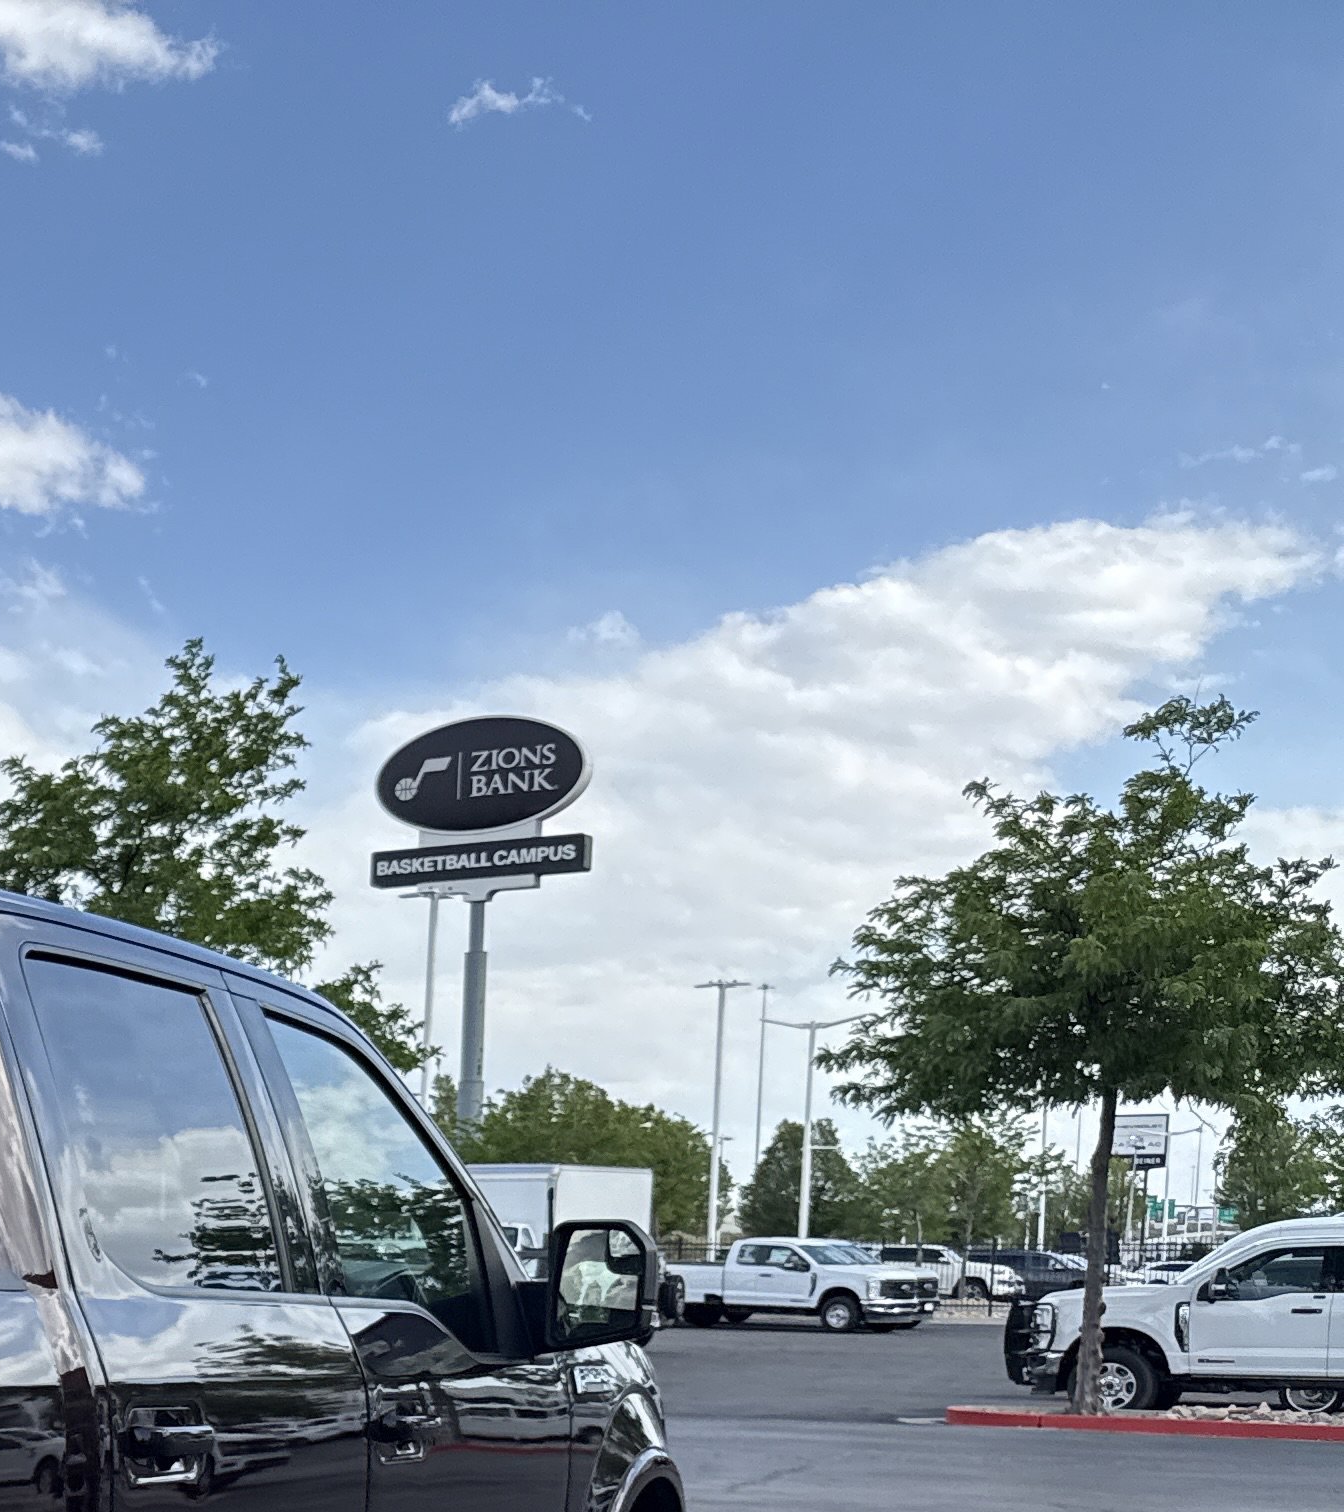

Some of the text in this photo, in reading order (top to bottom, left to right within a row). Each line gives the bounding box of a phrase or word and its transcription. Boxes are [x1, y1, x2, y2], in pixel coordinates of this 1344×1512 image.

[470, 743, 556, 772] ZIONS
[469, 769, 556, 798] BANK
[376, 844, 576, 877] BASKETBALL CAMPUS
